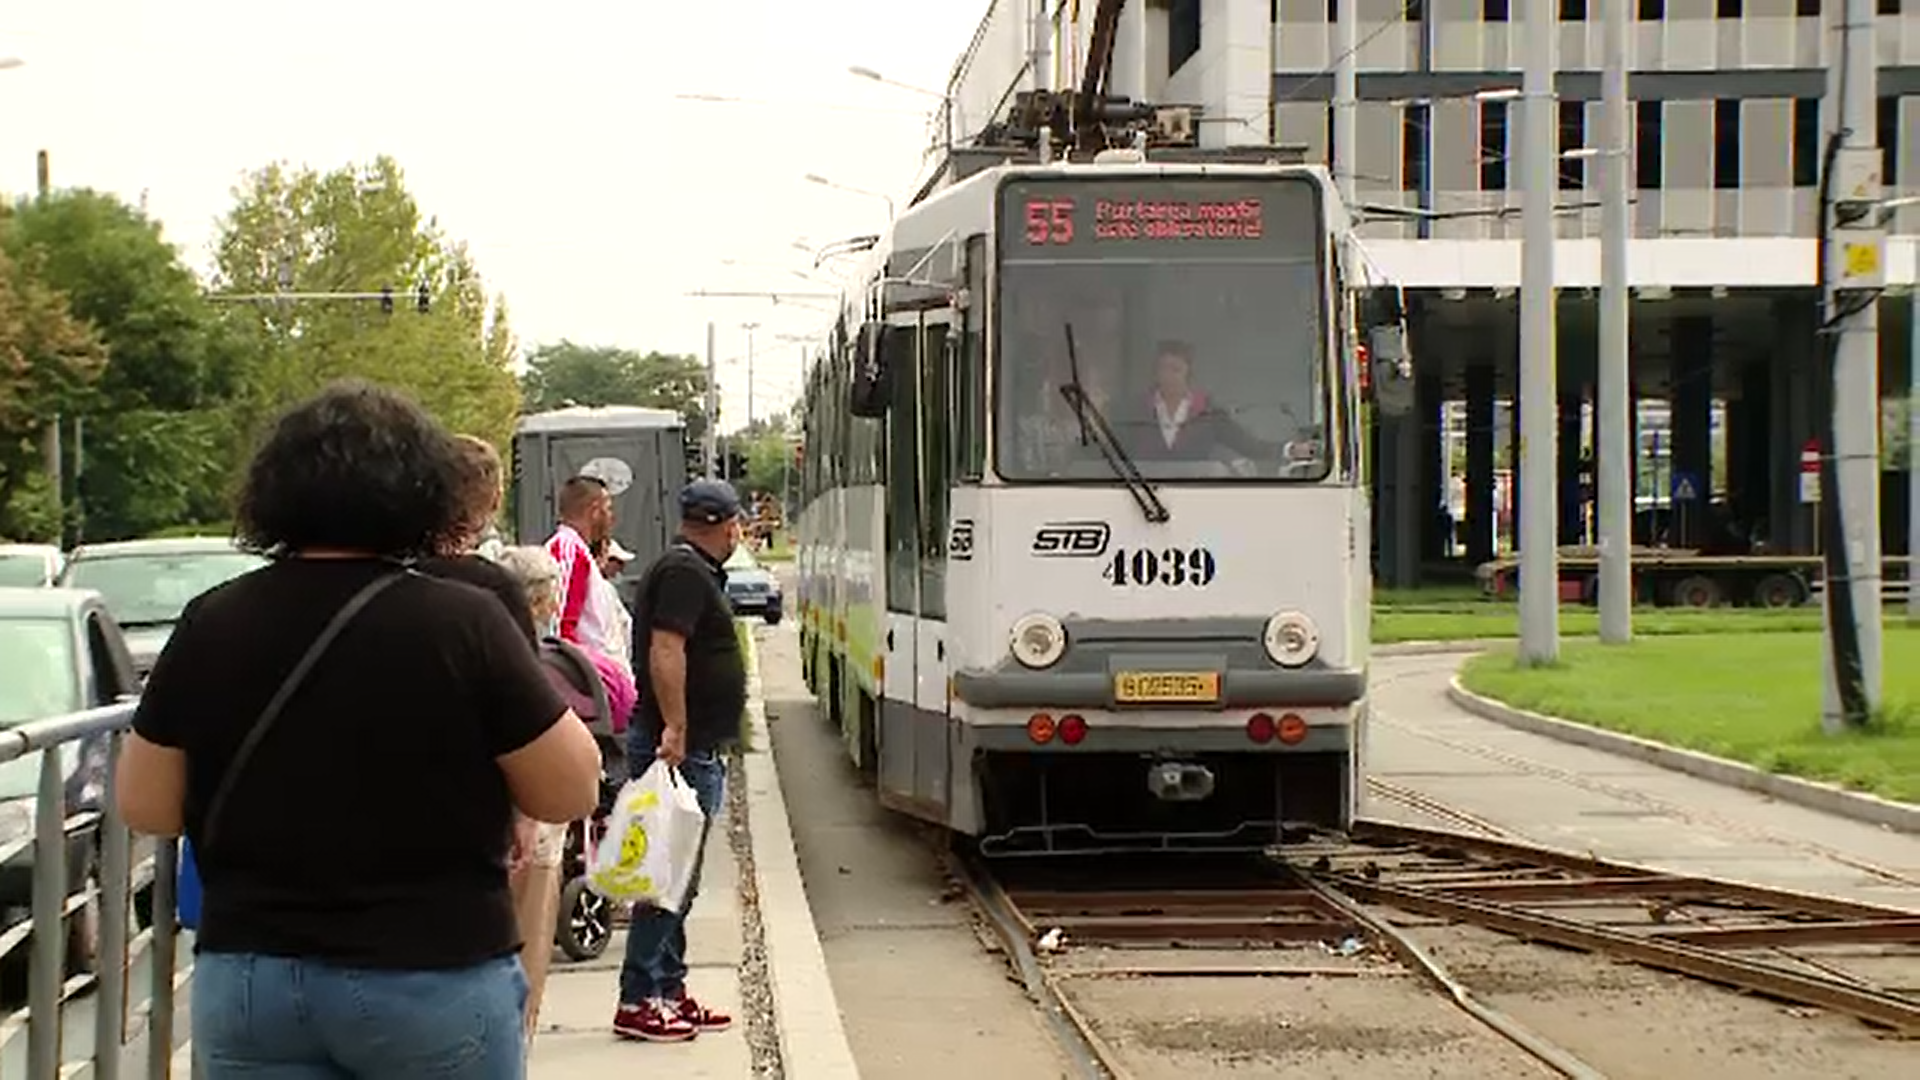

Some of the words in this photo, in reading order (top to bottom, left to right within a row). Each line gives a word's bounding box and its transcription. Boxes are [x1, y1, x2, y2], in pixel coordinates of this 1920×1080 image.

[1025, 202, 1074, 243] 55
[1033, 529, 1103, 551] STB
[1102, 548, 1215, 586] 4039
